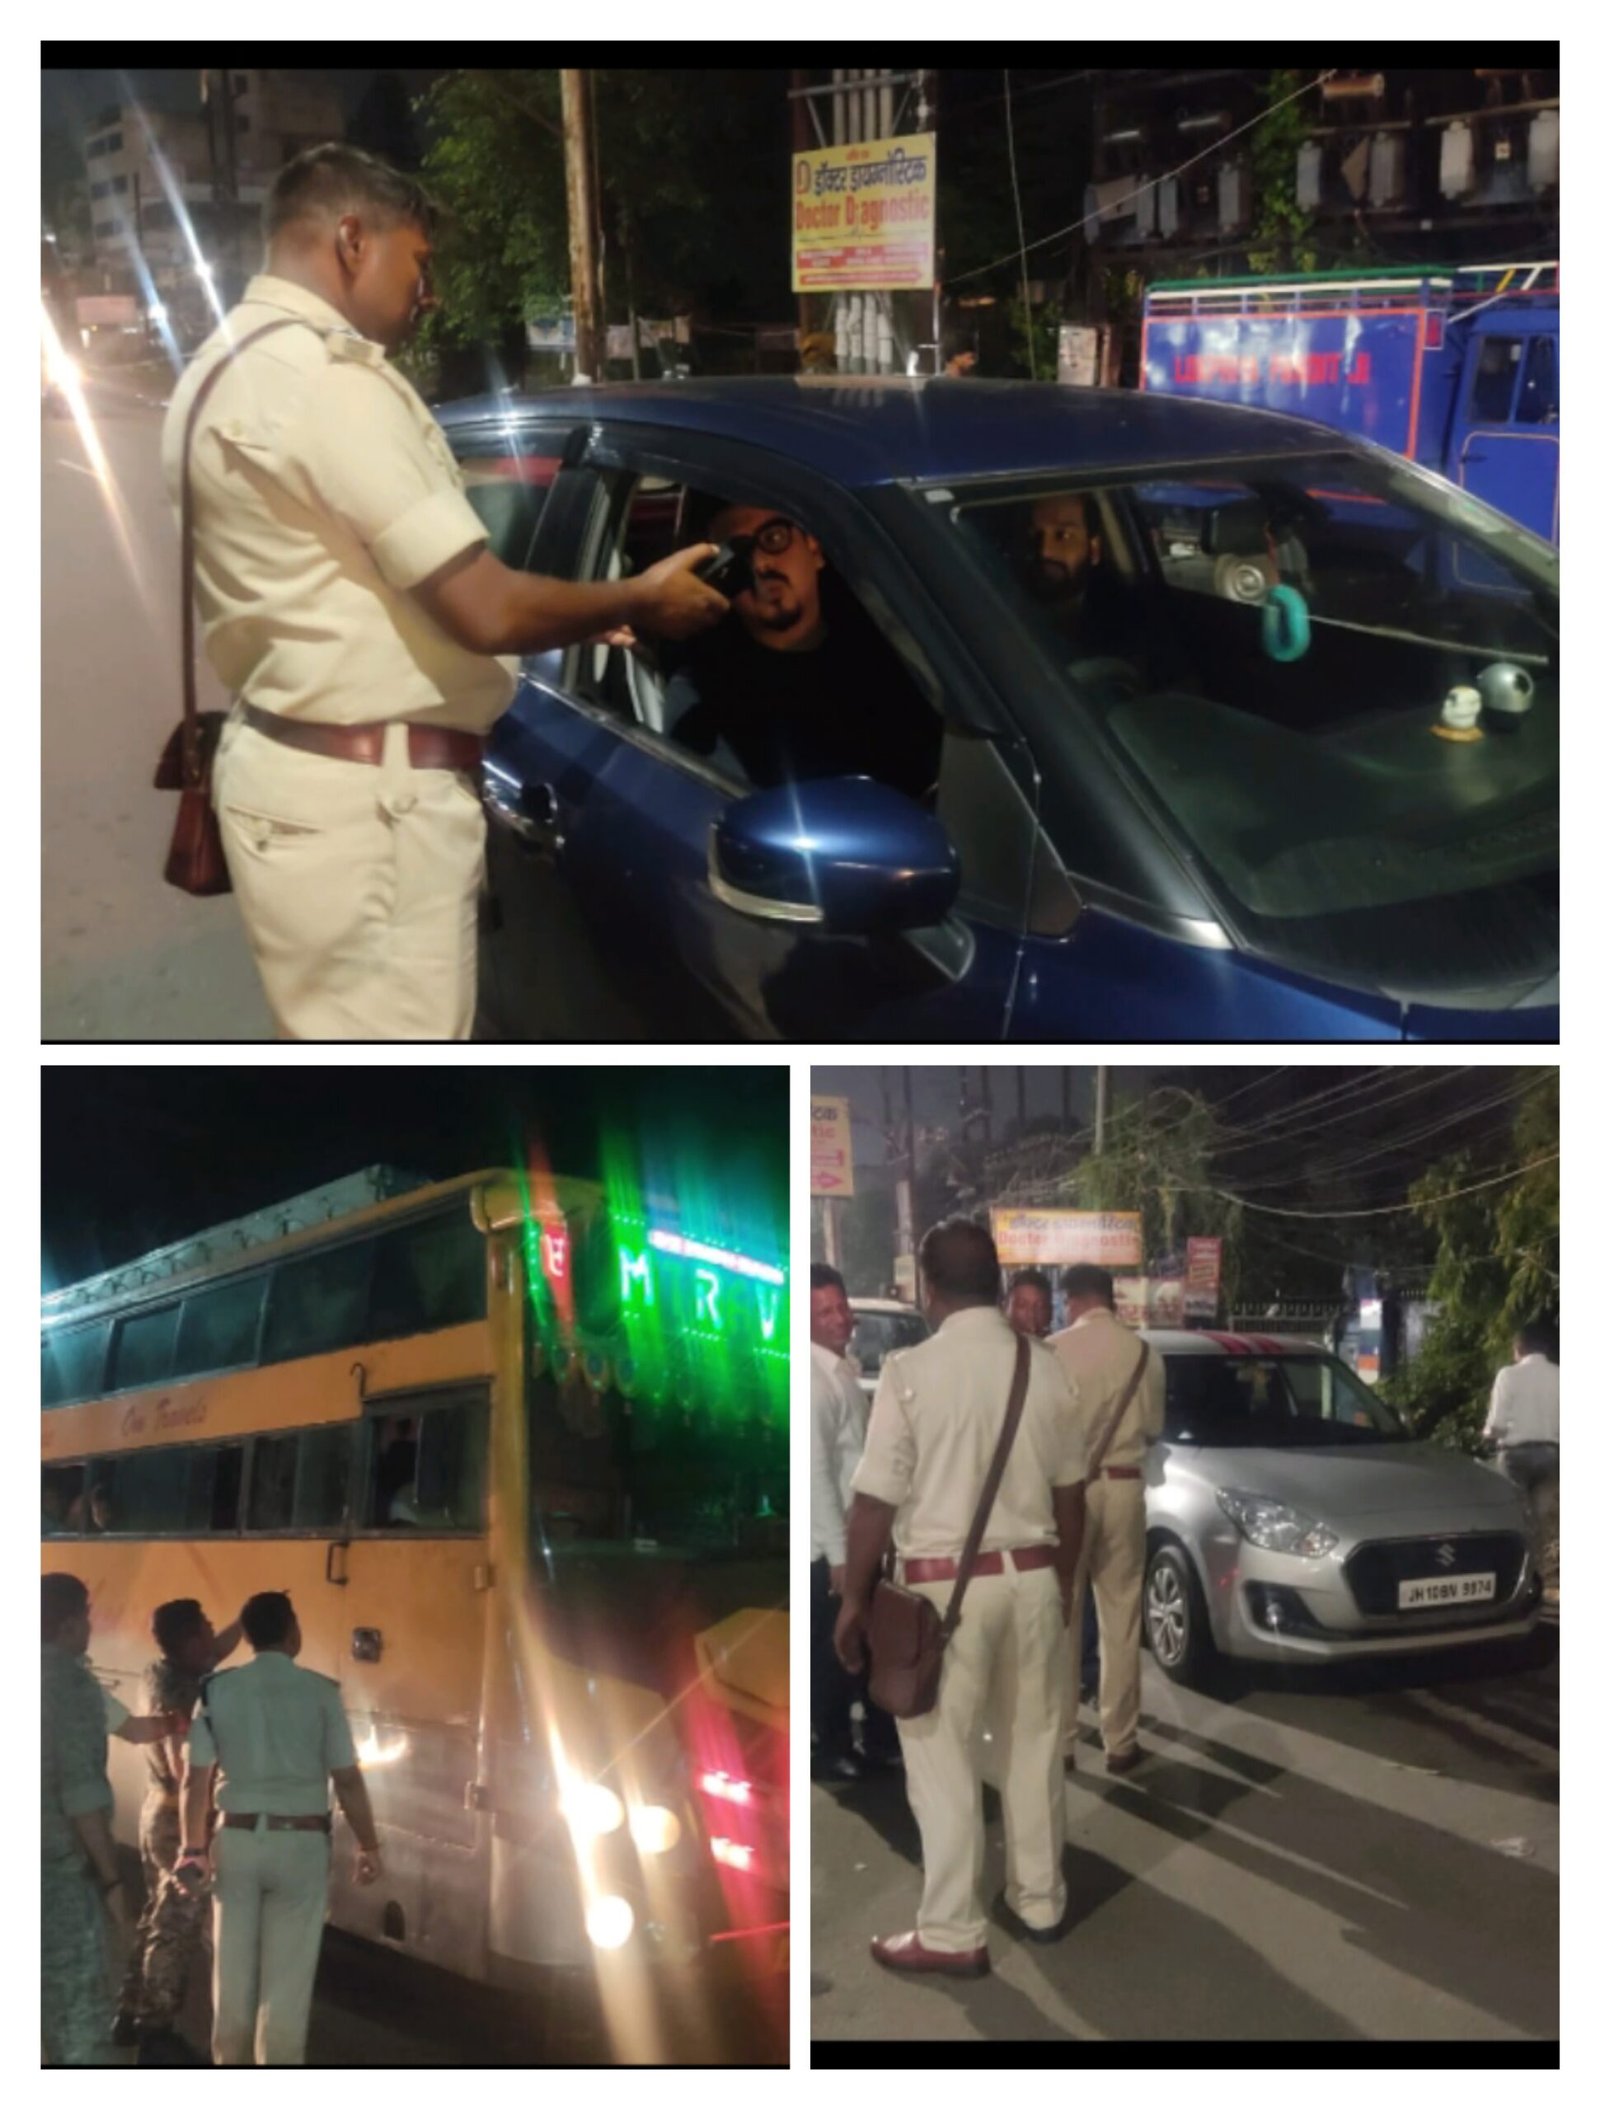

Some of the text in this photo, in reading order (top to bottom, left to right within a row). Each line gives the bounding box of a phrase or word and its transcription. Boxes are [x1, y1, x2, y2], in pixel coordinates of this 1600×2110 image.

[797, 200, 840, 231] Doctor
[998, 1230, 1142, 1248] Doctor Dgnostic
